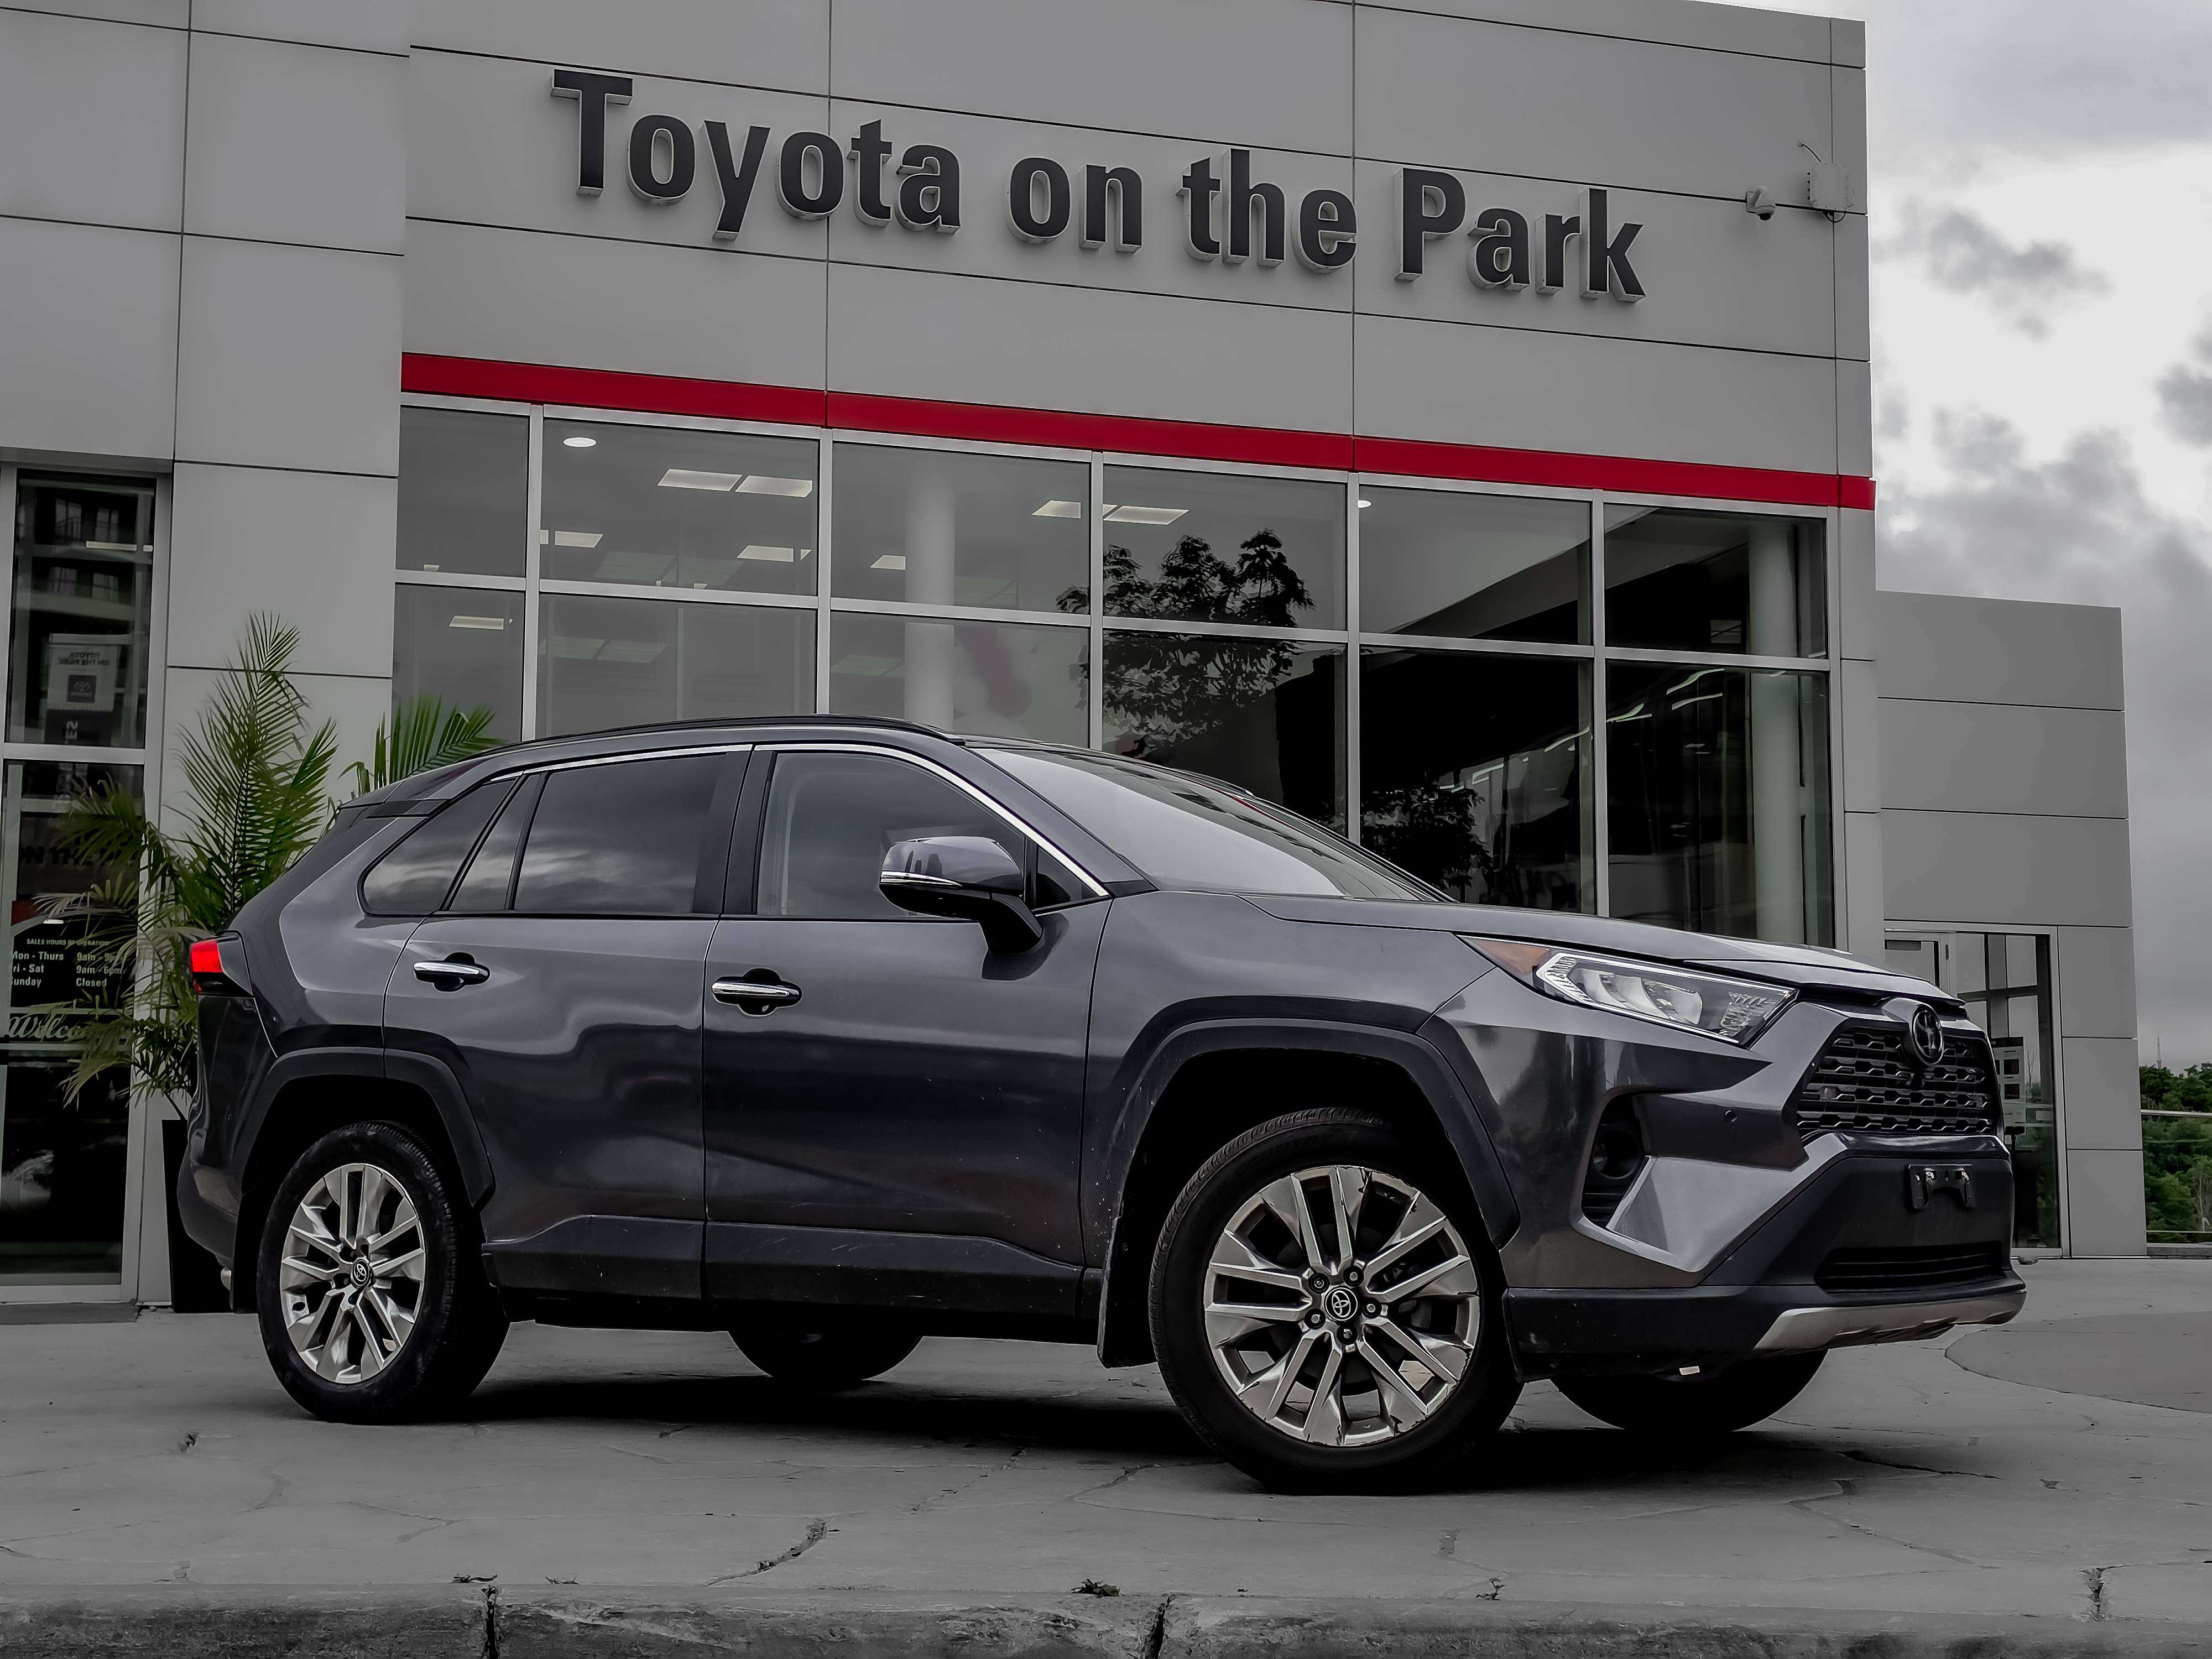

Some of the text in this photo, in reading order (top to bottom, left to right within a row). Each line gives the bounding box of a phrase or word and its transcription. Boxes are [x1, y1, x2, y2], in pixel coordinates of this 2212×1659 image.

[550, 68, 1646, 303] Toyota on the Park
[38, 951, 64, 961] Thurs
[29, 963, 44, 973] Sat
[76, 964, 95, 974] 9am
[12, 976, 107, 988] unday Closed
